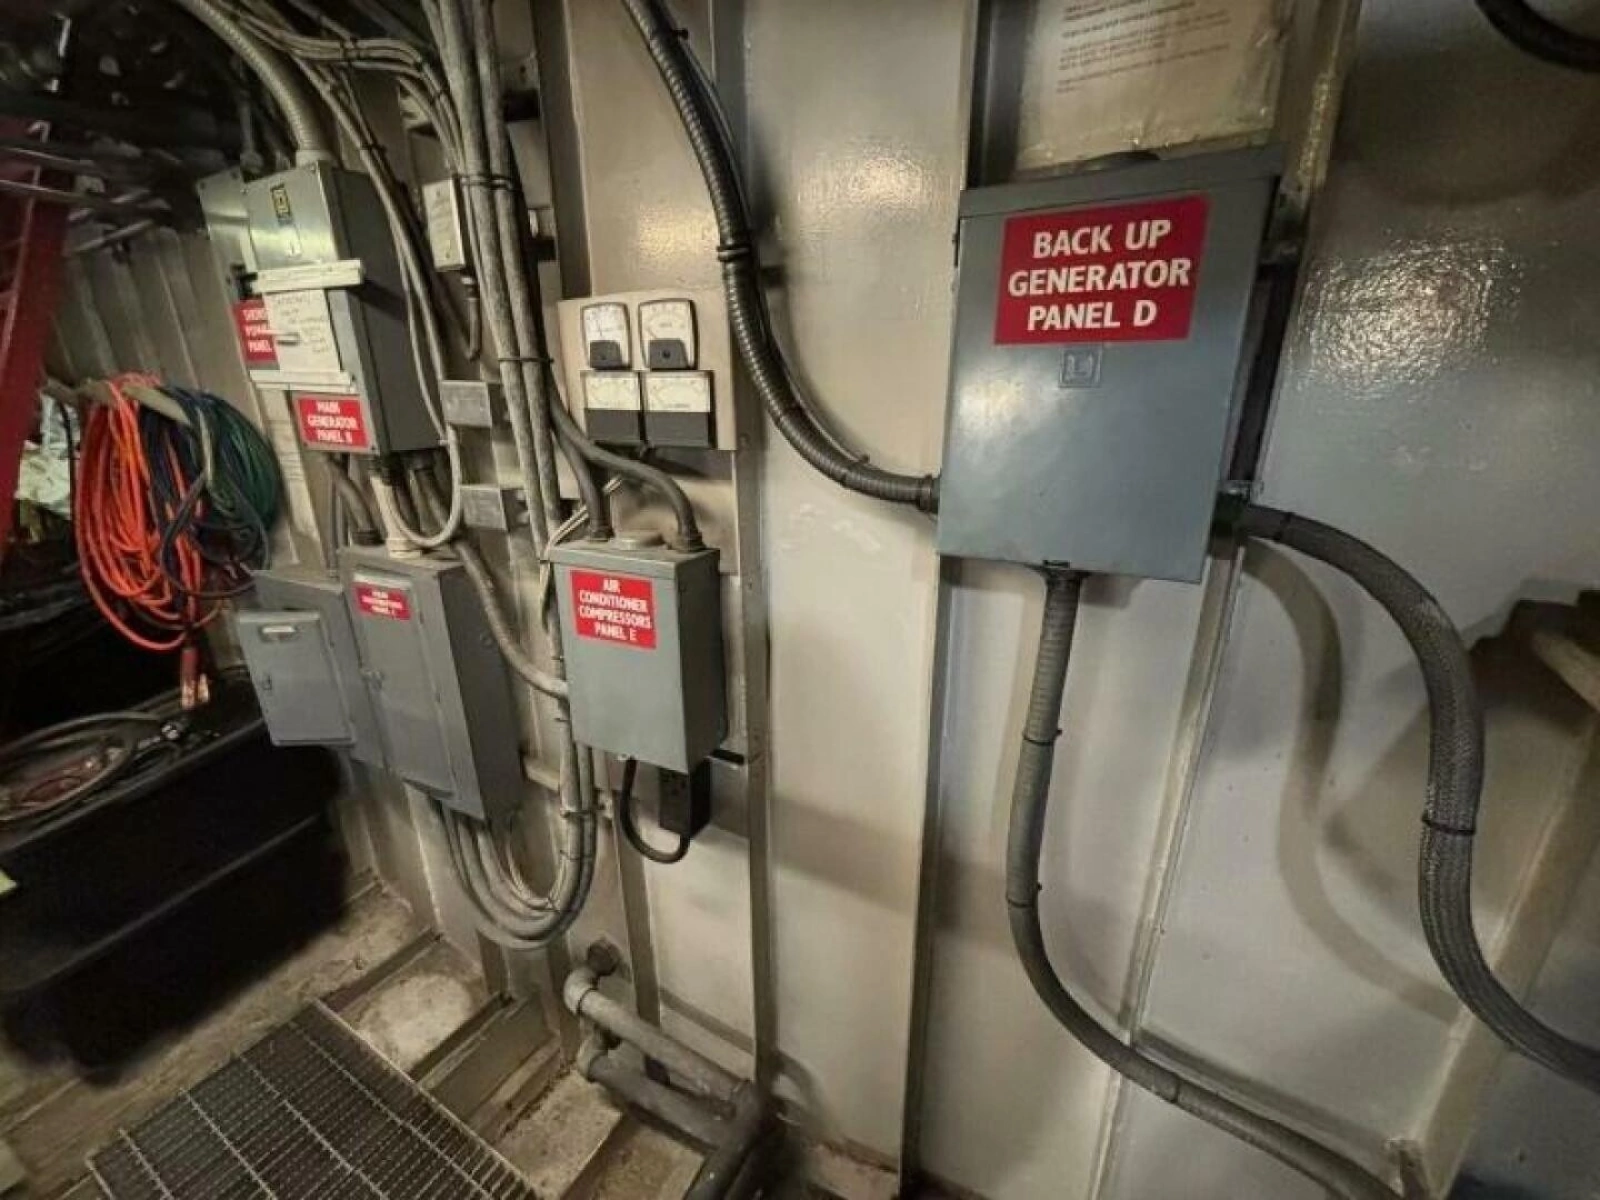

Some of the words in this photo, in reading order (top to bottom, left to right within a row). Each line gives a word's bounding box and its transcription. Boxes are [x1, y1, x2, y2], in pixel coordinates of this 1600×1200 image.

[1032, 224, 1113, 259] BACK
[1125, 219, 1171, 251] UP
[1007, 257, 1192, 297] GENERATOR
[1026, 301, 1121, 331] PANEL
[1133, 299, 1158, 327] D
[316, 400, 341, 414] MAIN
[307, 413, 359, 430] GENERATOR
[317, 430, 344, 443] PANEL
[603, 578, 621, 593] AIR
[579, 589, 649, 613] CONDITIONER
[579, 605, 652, 629] COMPRESSORS
[594, 621, 628, 640] PANEL
[629, 628, 637, 641] E
